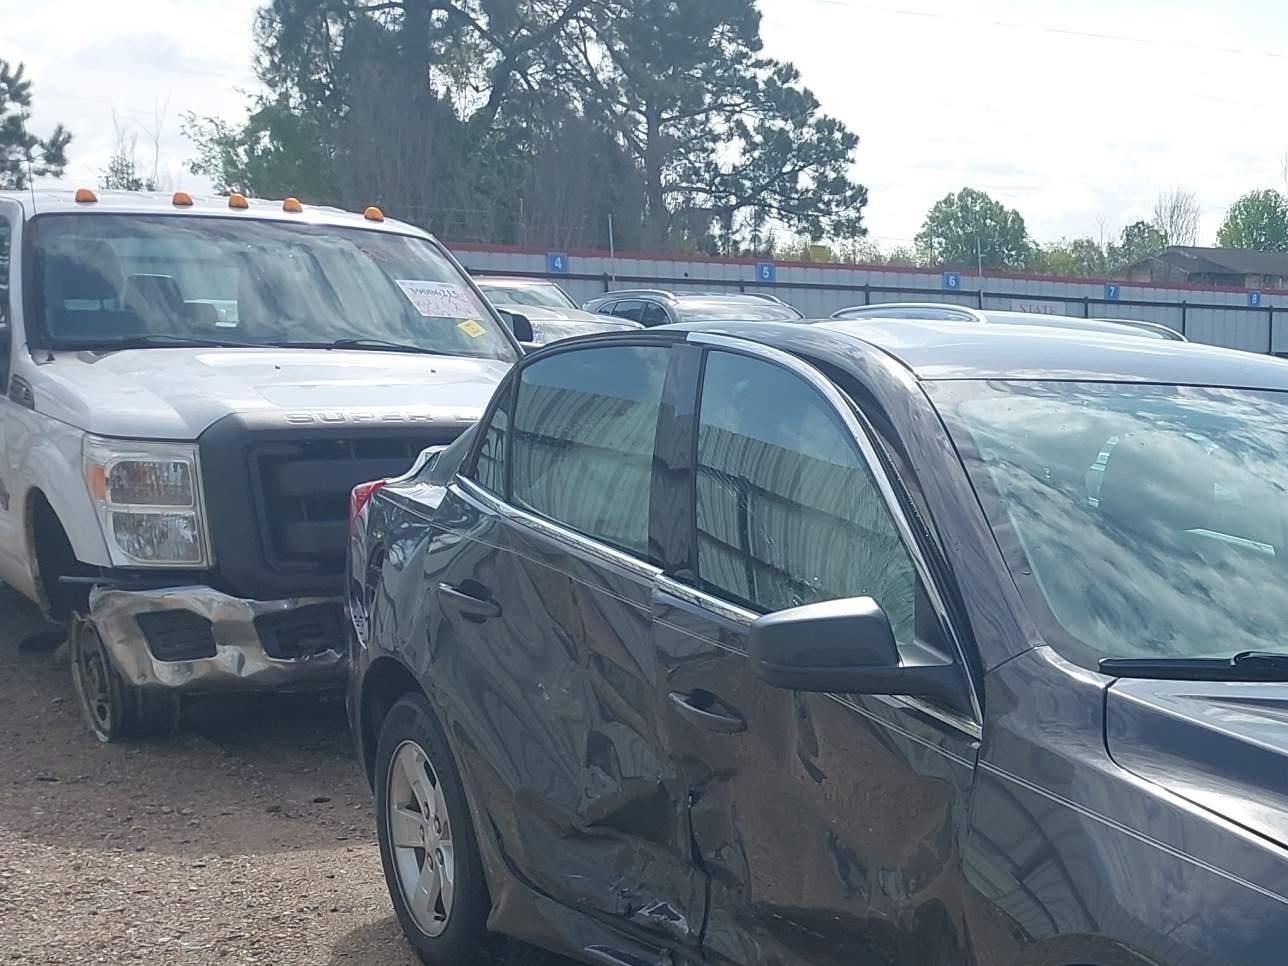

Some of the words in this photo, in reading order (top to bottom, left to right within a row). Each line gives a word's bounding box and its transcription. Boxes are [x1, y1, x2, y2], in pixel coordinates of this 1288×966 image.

[554, 257, 563, 269] 4
[762, 266, 770, 279] 5
[948, 275, 956, 286] 6
[285, 412, 434, 424] SUPER
